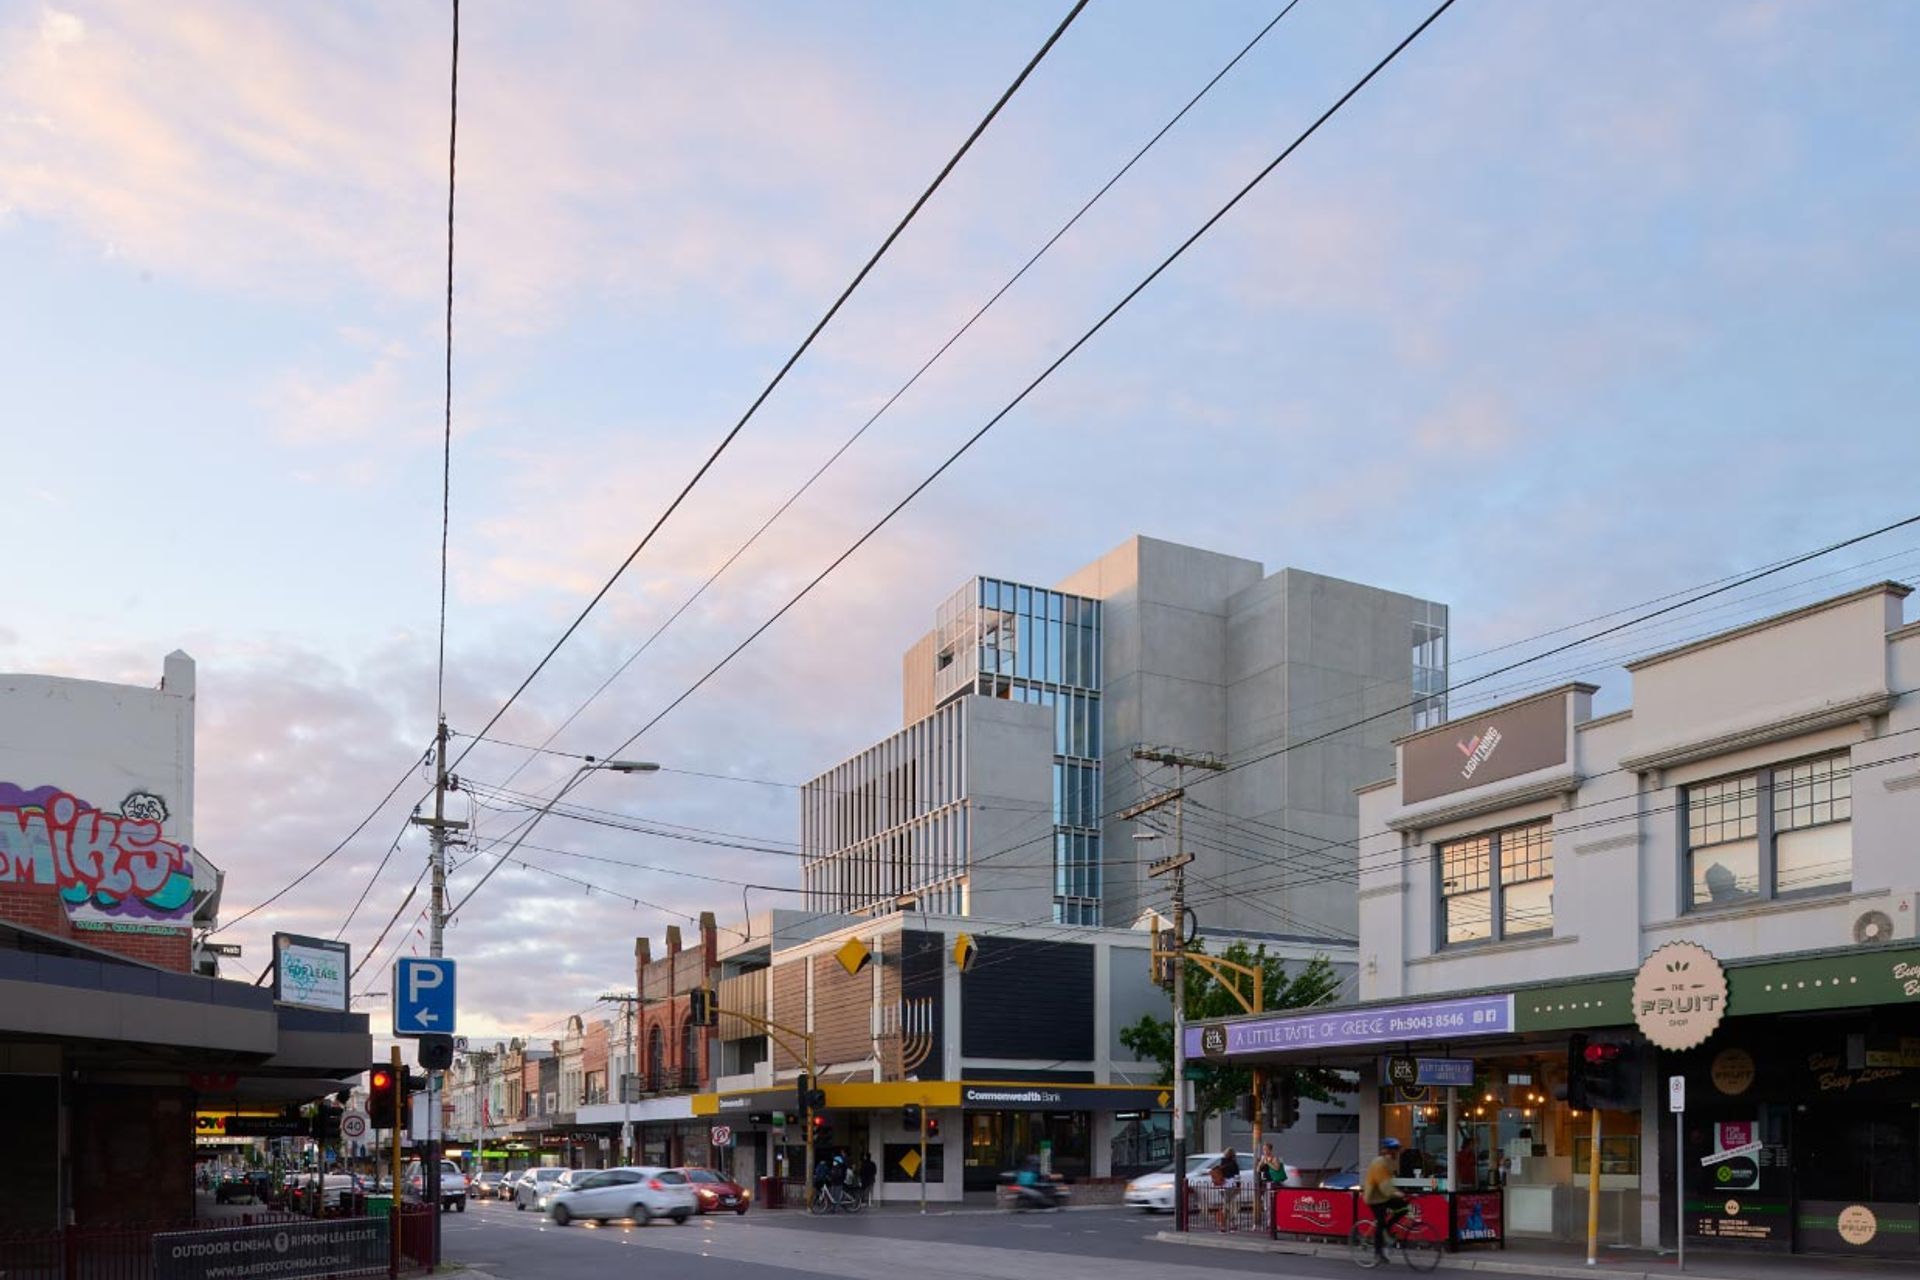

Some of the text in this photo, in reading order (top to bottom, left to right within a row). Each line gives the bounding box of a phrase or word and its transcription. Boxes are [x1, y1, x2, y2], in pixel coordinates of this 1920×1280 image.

[1461, 726, 1498, 779] LIGHTNING
[409, 962, 444, 1003] P
[1640, 994, 1719, 1016] FRUIT
[1236, 1032, 1244, 1046] A
[1247, 1028, 1281, 1045] LITTLE
[1284, 1024, 1315, 1041] TASTE
[1320, 1022, 1337, 1037] OF
[1341, 1017, 1383, 1036] GREECE
[967, 1090, 1061, 1102] Commonwealth Bank
[346, 1121, 361, 1131] 40
[172, 1242, 231, 1258] OUTDOOR
[232, 1238, 272, 1252] CINEMA
